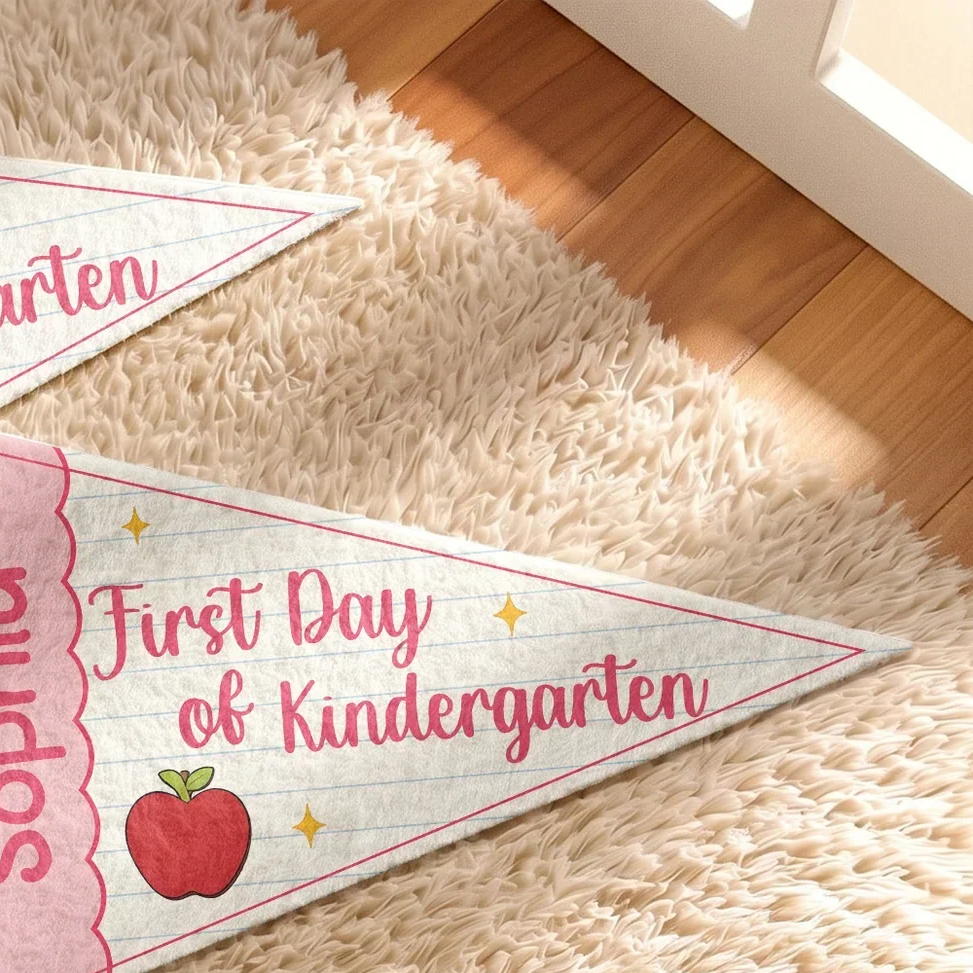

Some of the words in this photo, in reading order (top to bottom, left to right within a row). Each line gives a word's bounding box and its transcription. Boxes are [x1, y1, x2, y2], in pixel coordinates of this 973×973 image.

[88, 579, 263, 679] First
[287, 568, 432, 668] Day
[179, 669, 253, 748] of
[281, 654, 709, 762] Kindergarten
